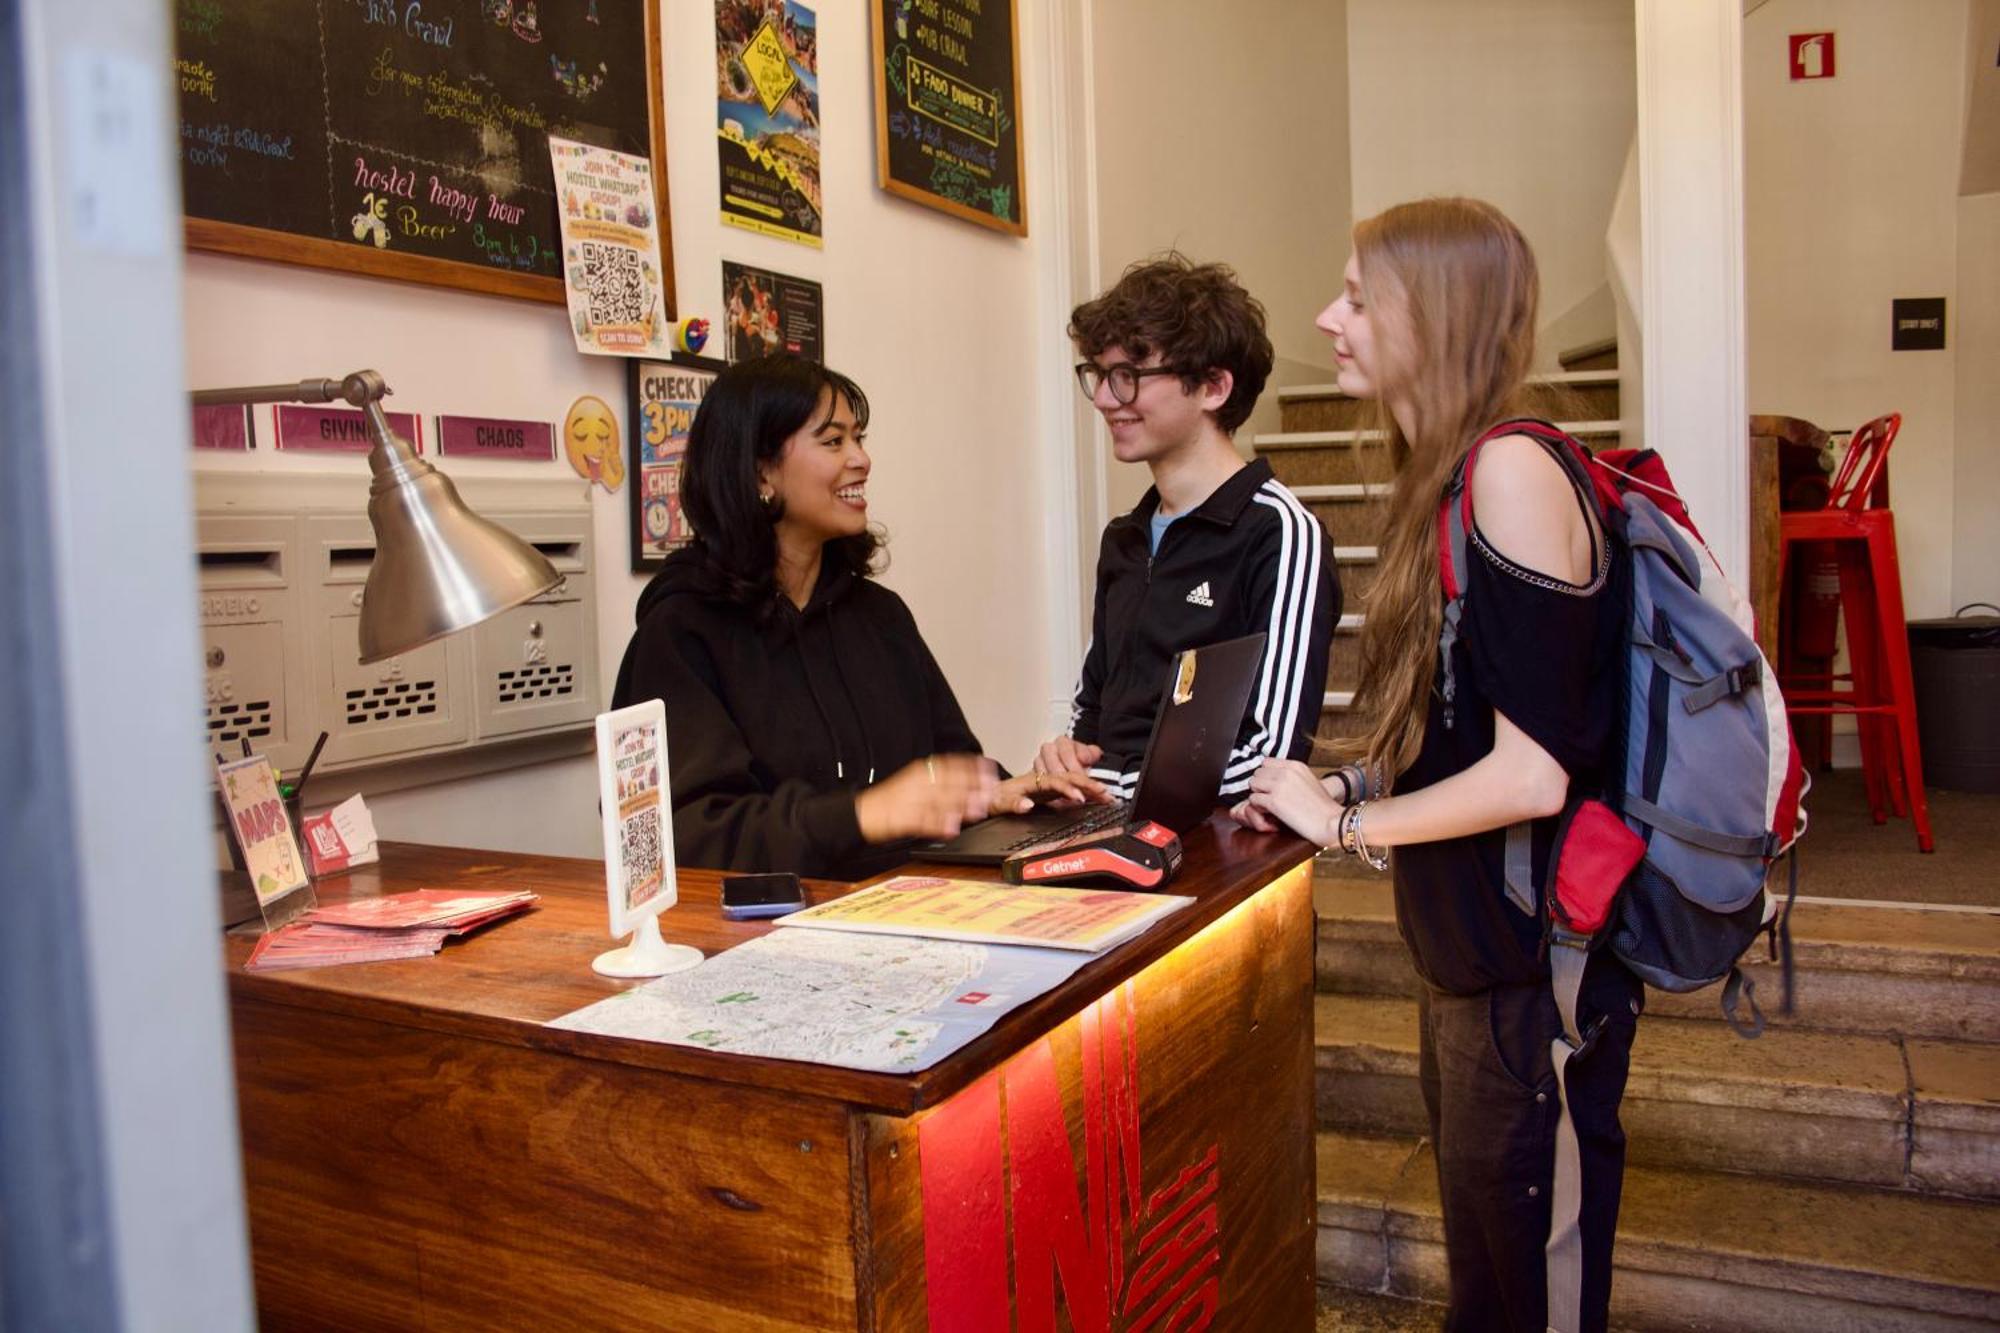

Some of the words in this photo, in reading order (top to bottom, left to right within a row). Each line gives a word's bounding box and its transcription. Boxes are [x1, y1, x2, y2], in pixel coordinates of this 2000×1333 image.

[405, 2, 454, 48] Crawl
[923, 69, 949, 97] FADO
[951, 84, 984, 116] DINNER
[354, 157, 416, 200] hostel
[428, 175, 479, 223] happy
[487, 193, 525, 225] hour
[566, 170, 598, 190] HOSTEL
[645, 376, 697, 400] CHECK
[319, 418, 372, 441] GIVIN
[644, 402, 691, 446] 3PM
[476, 427, 525, 450] CHAOS
[648, 472, 680, 496] CHE
[238, 799, 287, 848] MAPS
[1043, 857, 1087, 875] Getnet
